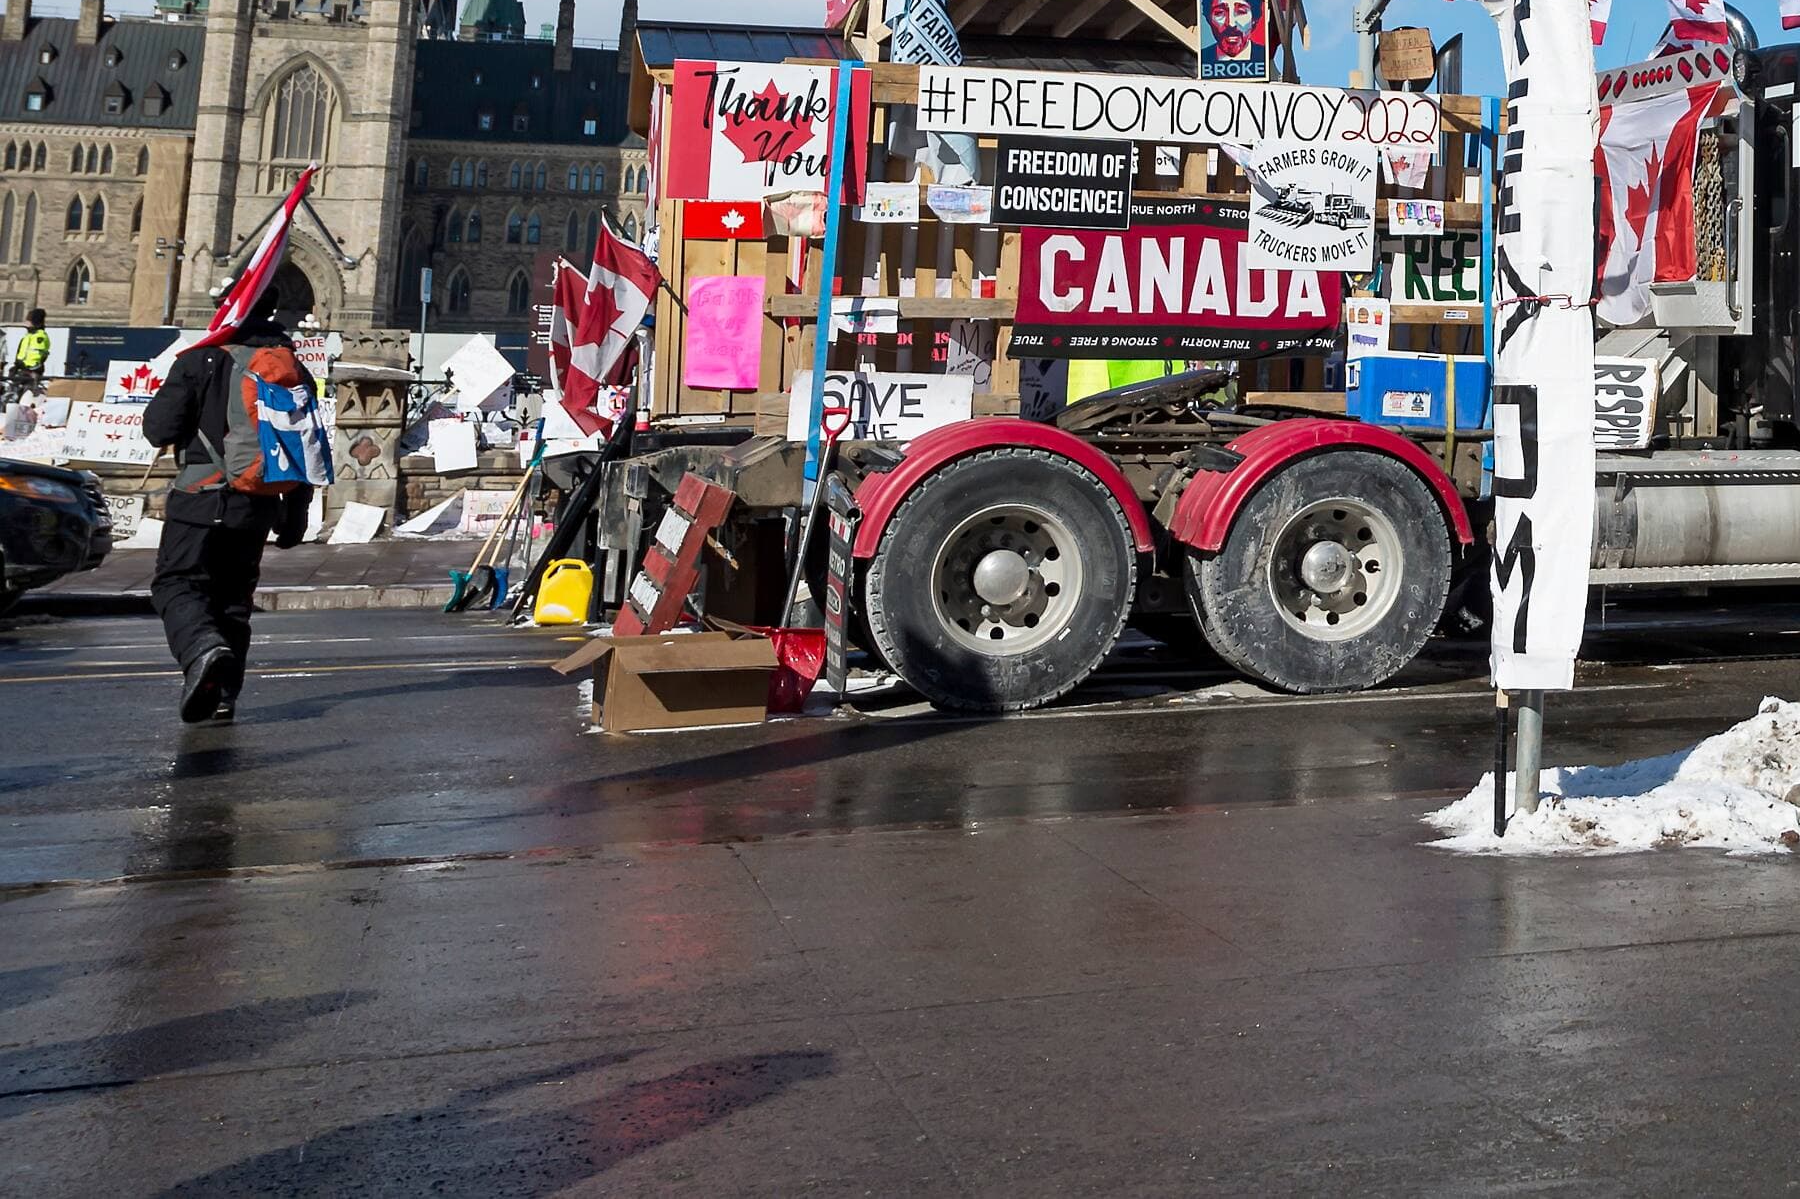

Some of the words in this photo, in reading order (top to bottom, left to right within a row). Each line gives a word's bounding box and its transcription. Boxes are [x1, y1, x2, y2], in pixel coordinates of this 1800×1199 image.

[1202, 62, 1265, 77] BROKE
[694, 67, 833, 130] Thank
[754, 130, 828, 187] You
[1007, 149, 1099, 178] FREEDOM
[1102, 154, 1127, 179] OF
[1257, 148, 1317, 180] FARMERS
[1320, 148, 1360, 174] GROW
[1359, 167, 1373, 183] IT
[1000, 184, 1124, 216] CONSCIENCE!
[1156, 203, 1196, 215] NORTH
[1218, 207, 1250, 220] STRO
[1254, 228, 1317, 263] TRUCKERS
[1321, 239, 1356, 262] MOVE
[1356, 232, 1370, 248] IT
[1039, 234, 1326, 318] CANADA
[1013, 335, 1045, 346] TRUE
[1069, 336, 1098, 347] FREE
[1101, 336, 1109, 346] &
[1111, 336, 1159, 346] STRONG
[1180, 337, 1220, 349] NORTH
[1221, 339, 1251, 349] TRUE
[824, 374, 928, 418] SAVE
